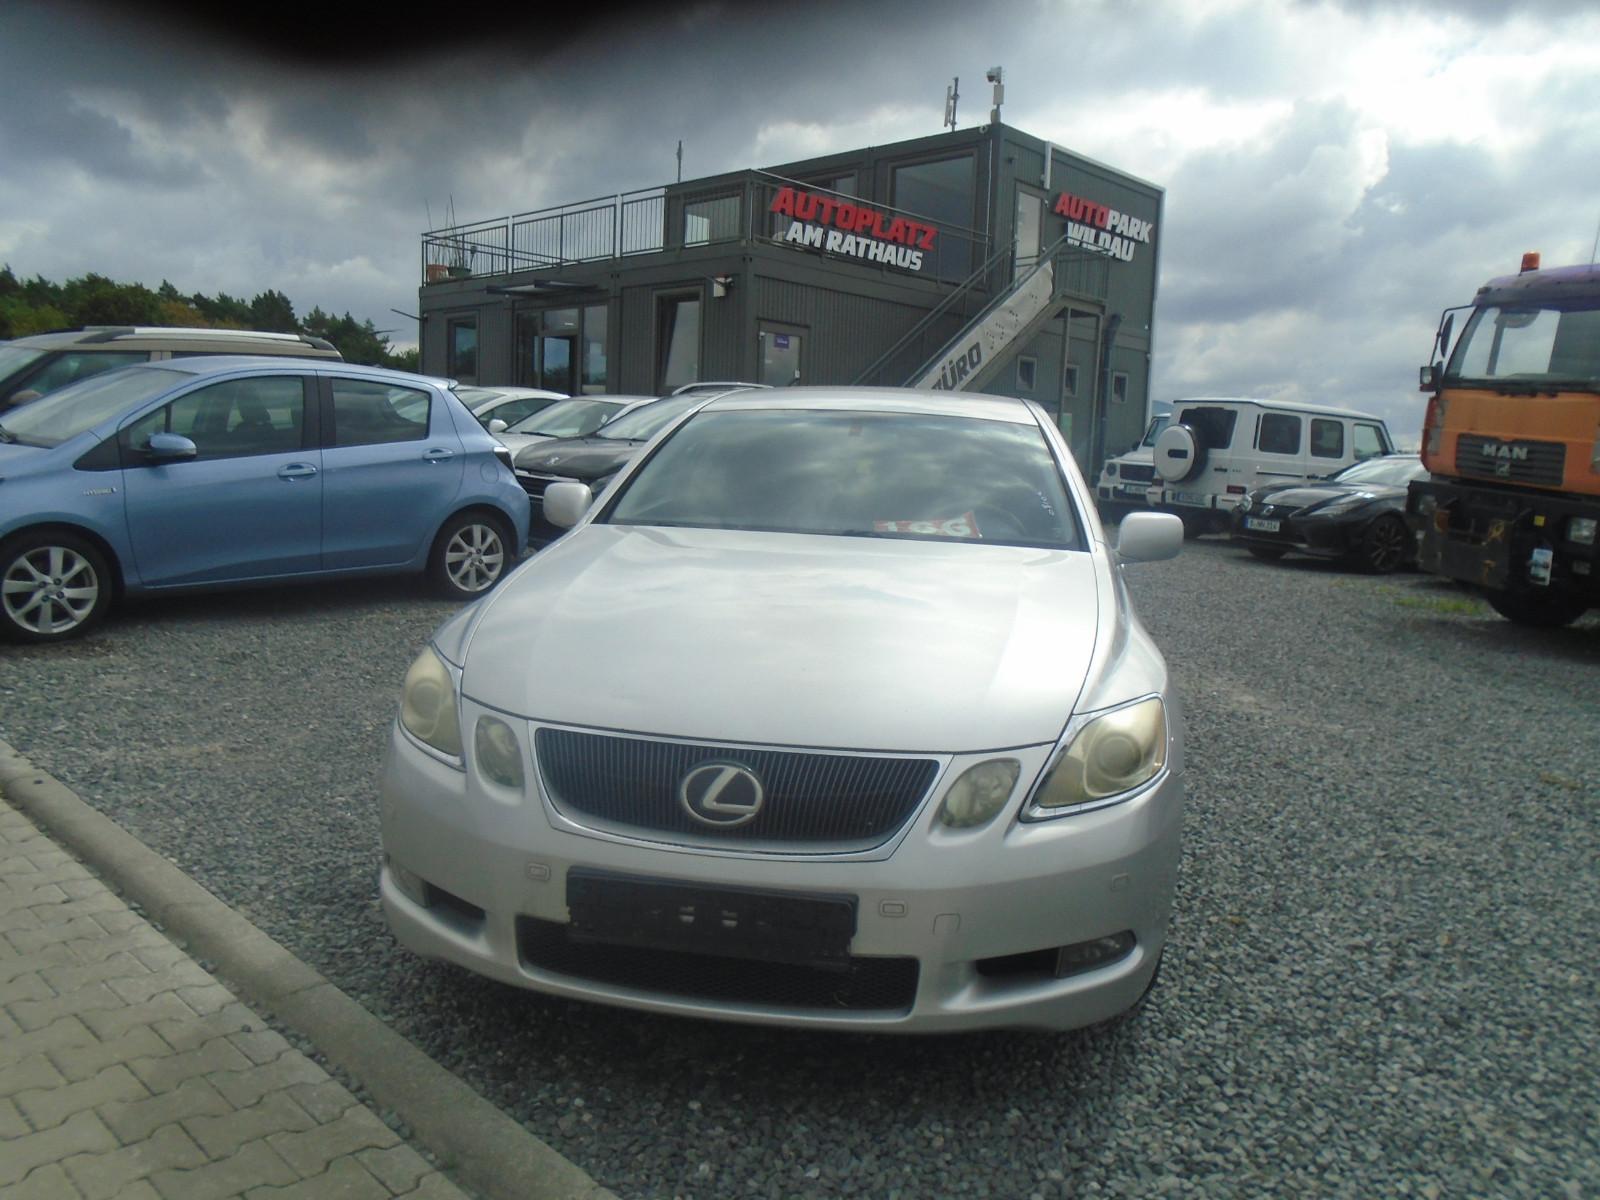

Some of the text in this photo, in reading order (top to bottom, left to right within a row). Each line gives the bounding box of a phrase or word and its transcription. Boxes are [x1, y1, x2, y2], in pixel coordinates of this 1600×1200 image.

[771, 186, 939, 250] AUTOPLATZ
[1055, 192, 1153, 244] AUTOPARK
[1067, 221, 1136, 262] WILDAU
[785, 221, 924, 271] AM RATHAUS
